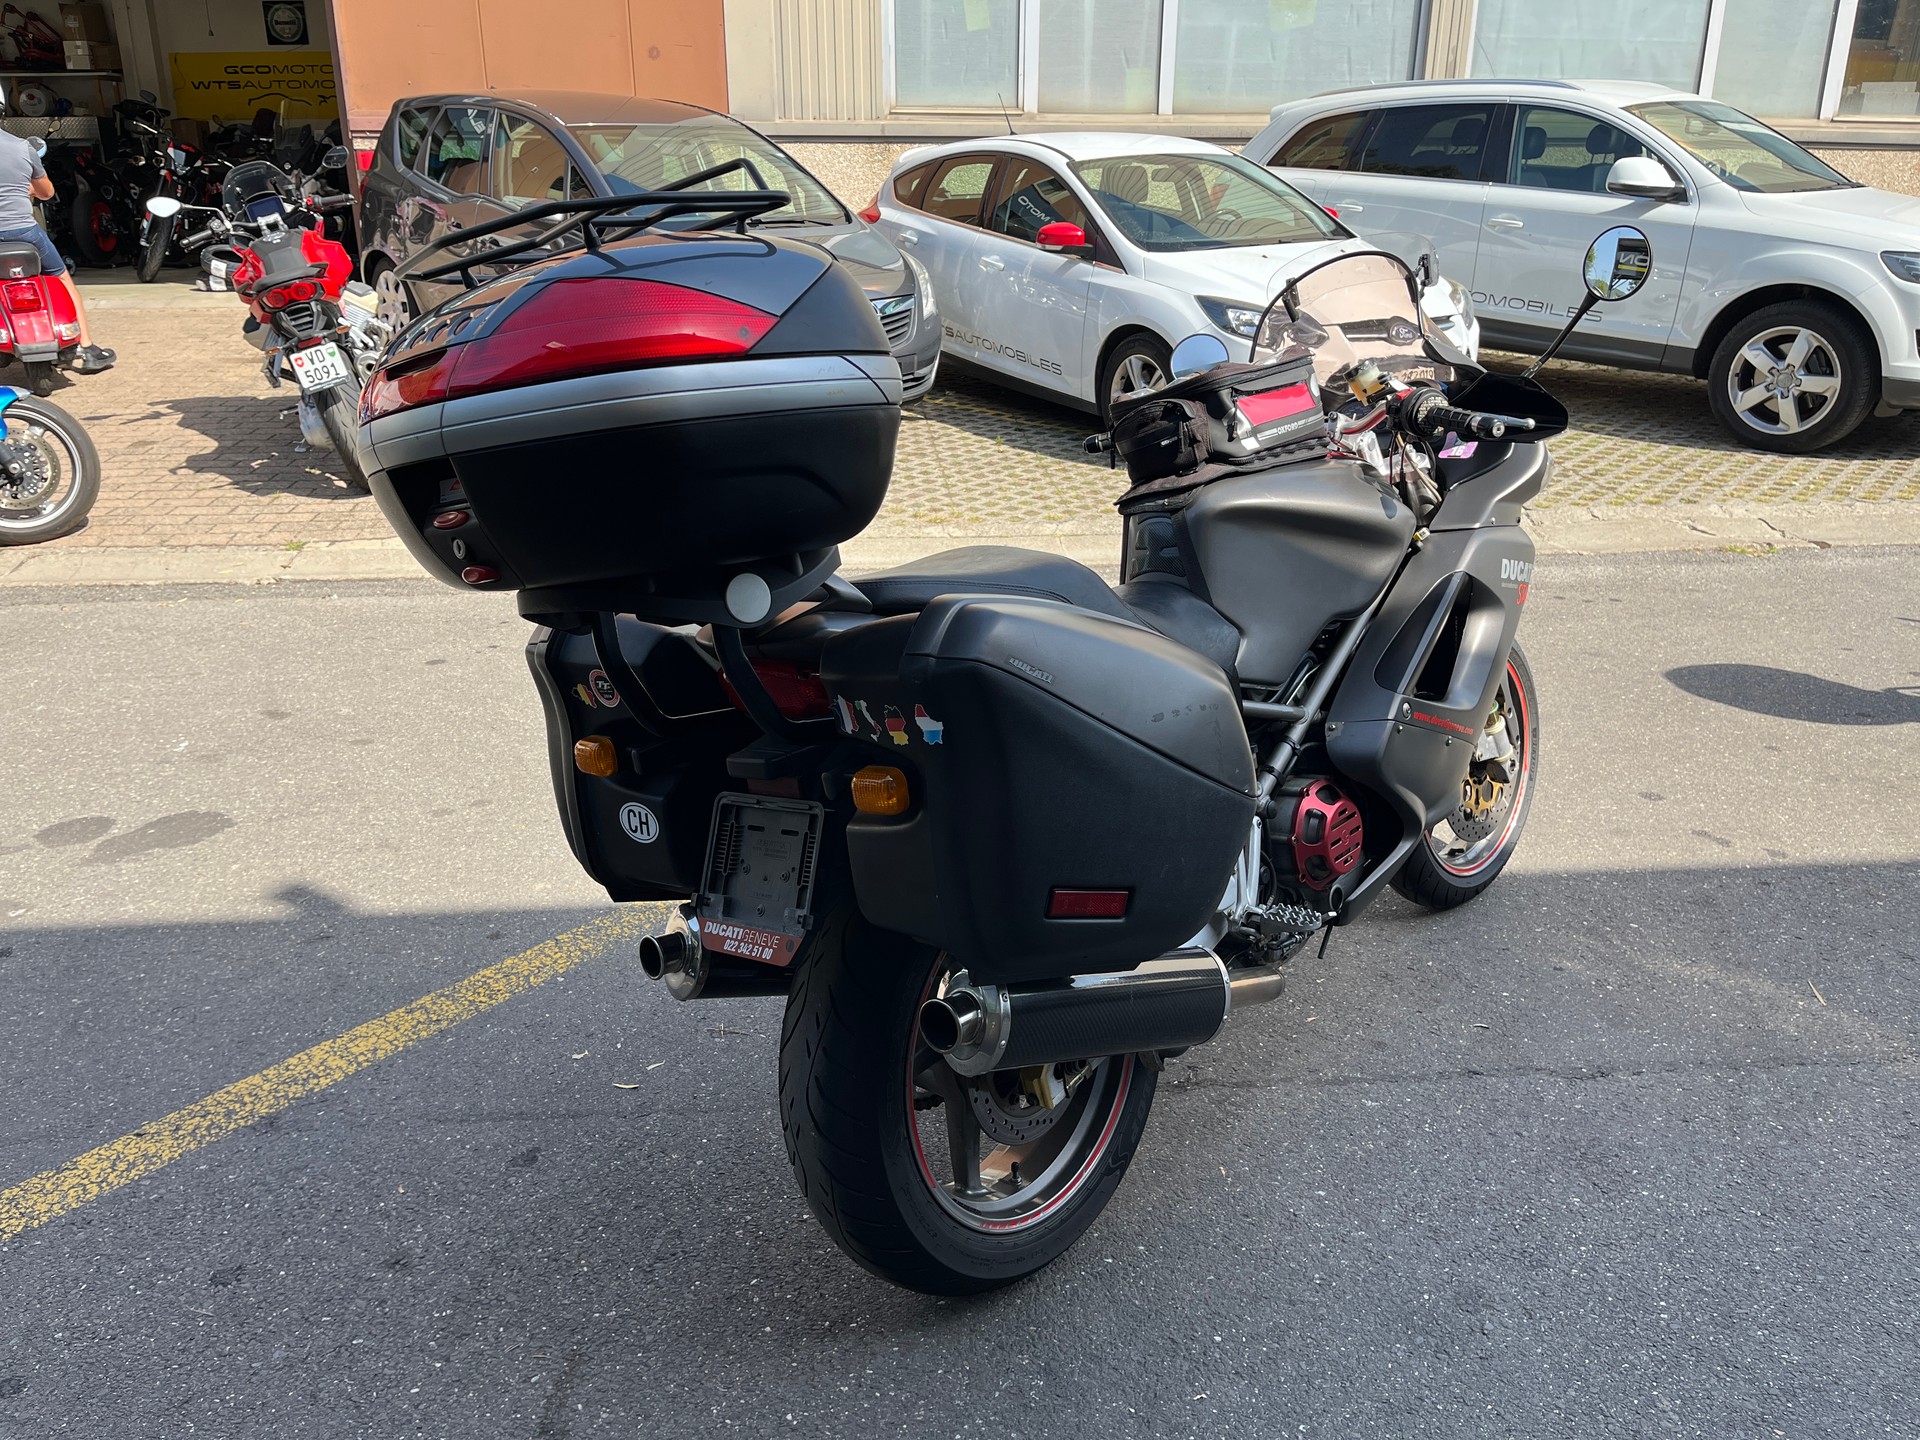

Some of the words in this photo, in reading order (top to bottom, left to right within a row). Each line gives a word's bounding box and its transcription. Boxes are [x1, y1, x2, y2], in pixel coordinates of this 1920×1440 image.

[305, 349, 325, 366] VD
[941, 324, 1063, 376] SAUTOMOBILES
[304, 362, 340, 383] 5091
[1277, 422, 1299, 435] OXFORD
[1008, 656, 1054, 684] DUCATI
[627, 808, 651, 837] CH
[723, 939, 738, 952] 022
[738, 942, 753, 955] 342
[752, 945, 761, 957] 51
[762, 948, 774, 960] 00
